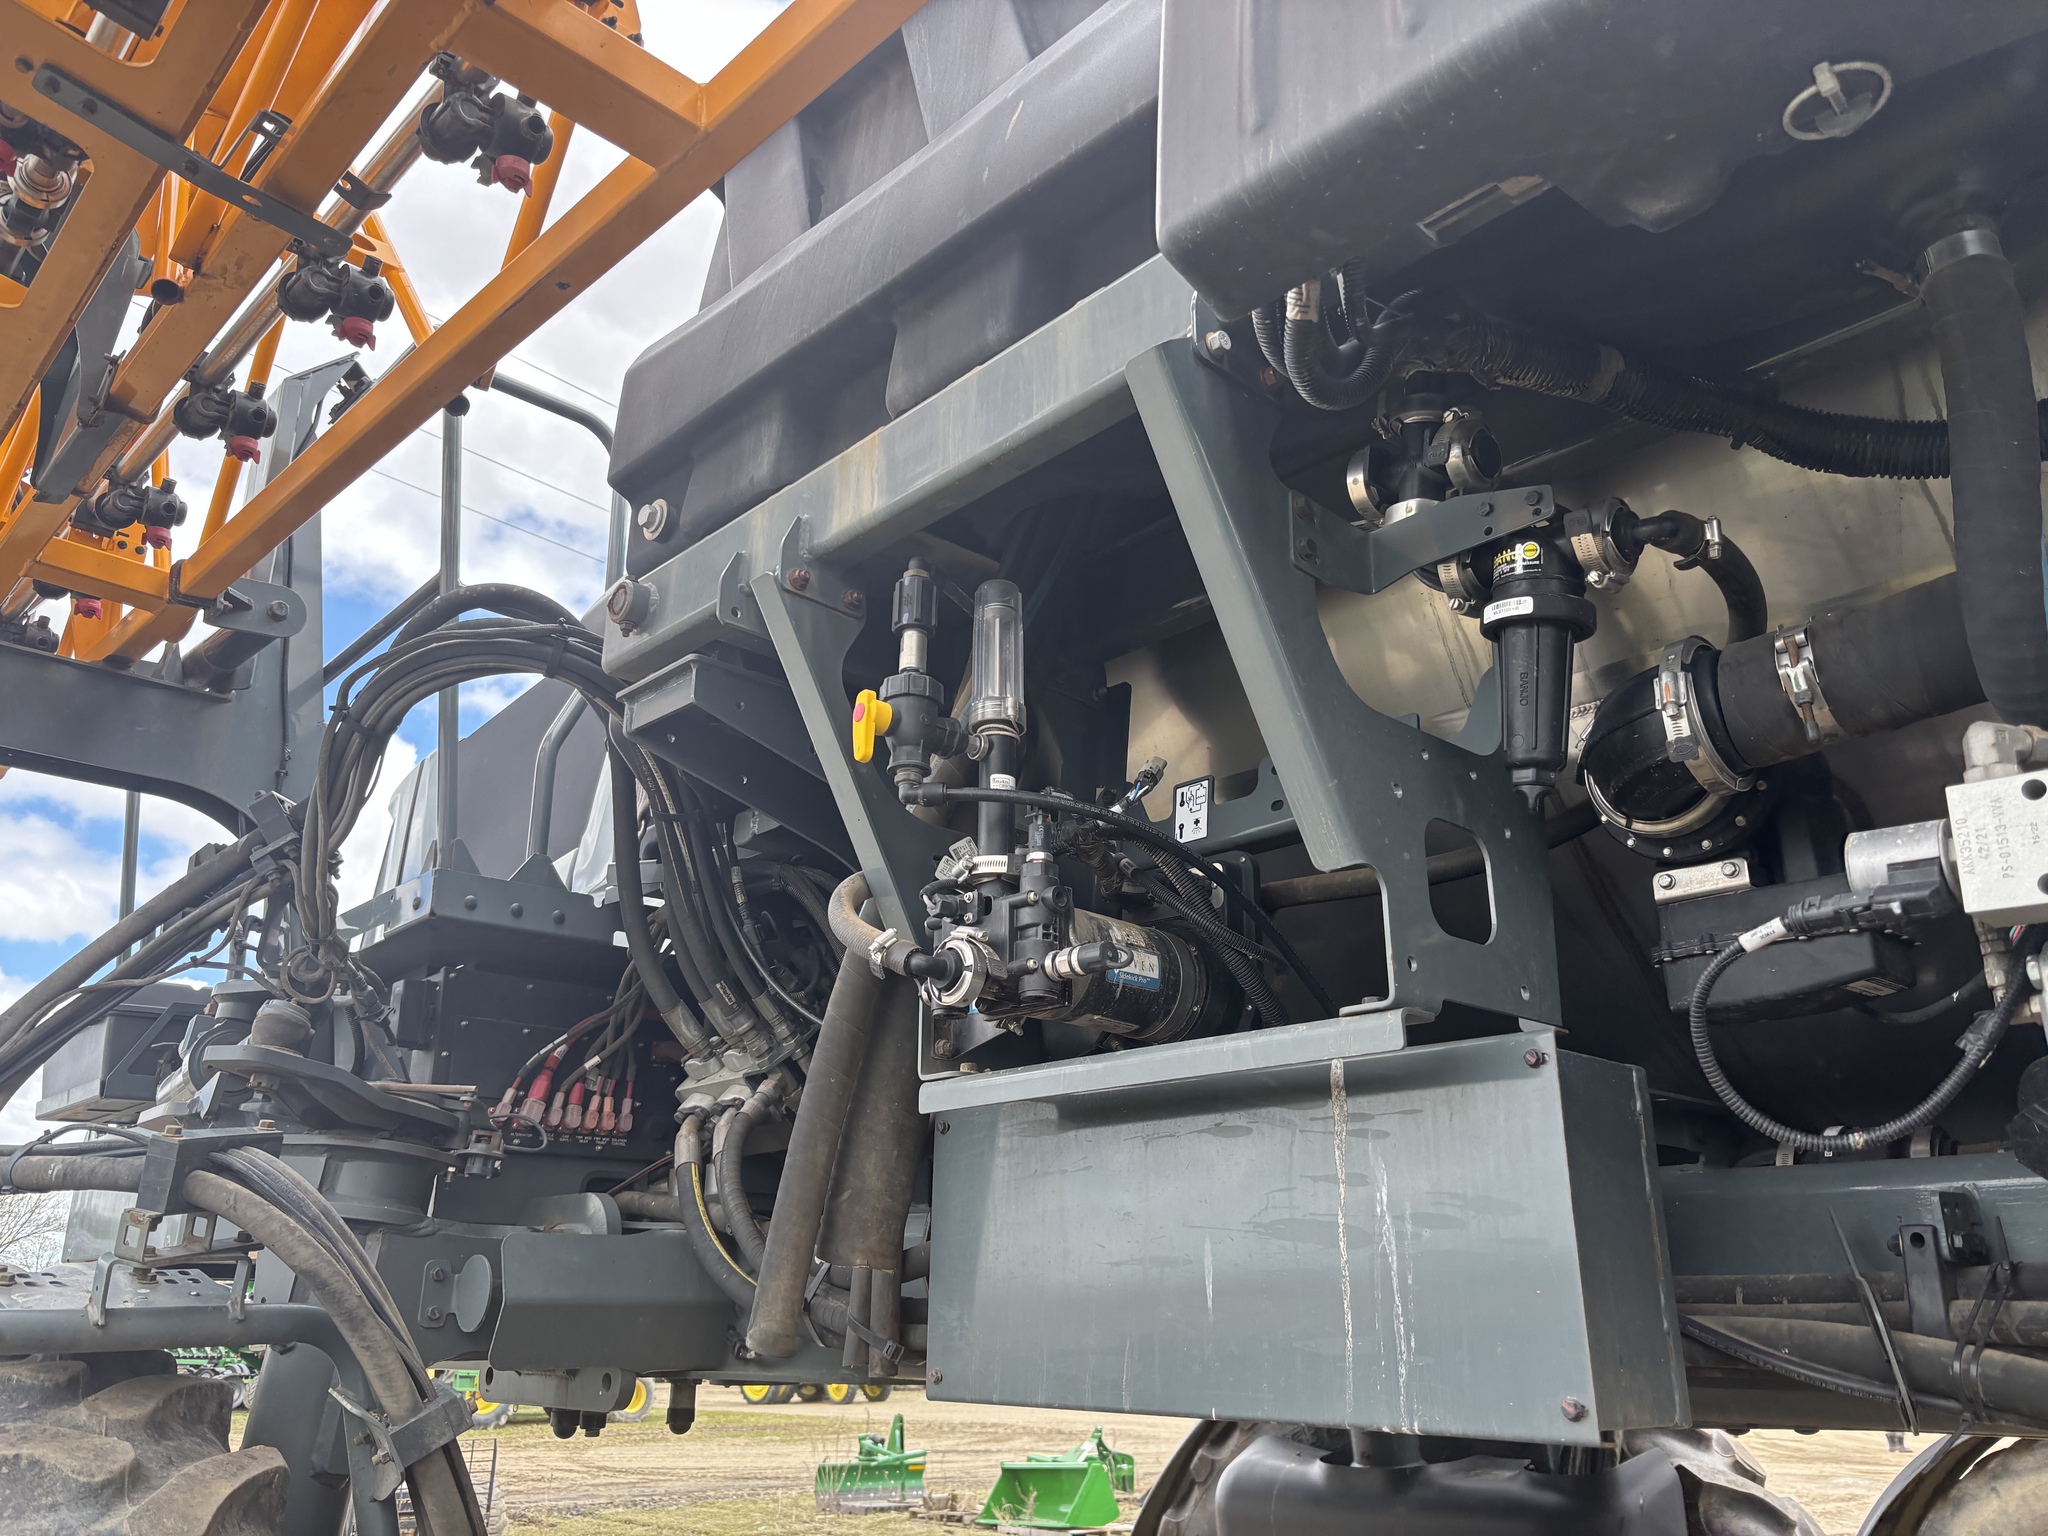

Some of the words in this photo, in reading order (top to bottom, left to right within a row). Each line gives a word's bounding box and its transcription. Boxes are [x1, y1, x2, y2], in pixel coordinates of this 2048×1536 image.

[1519, 671, 1529, 707] BANJO
[1955, 818, 1975, 875] AKK35210
[1118, 971, 1138, 982] Sidekick
